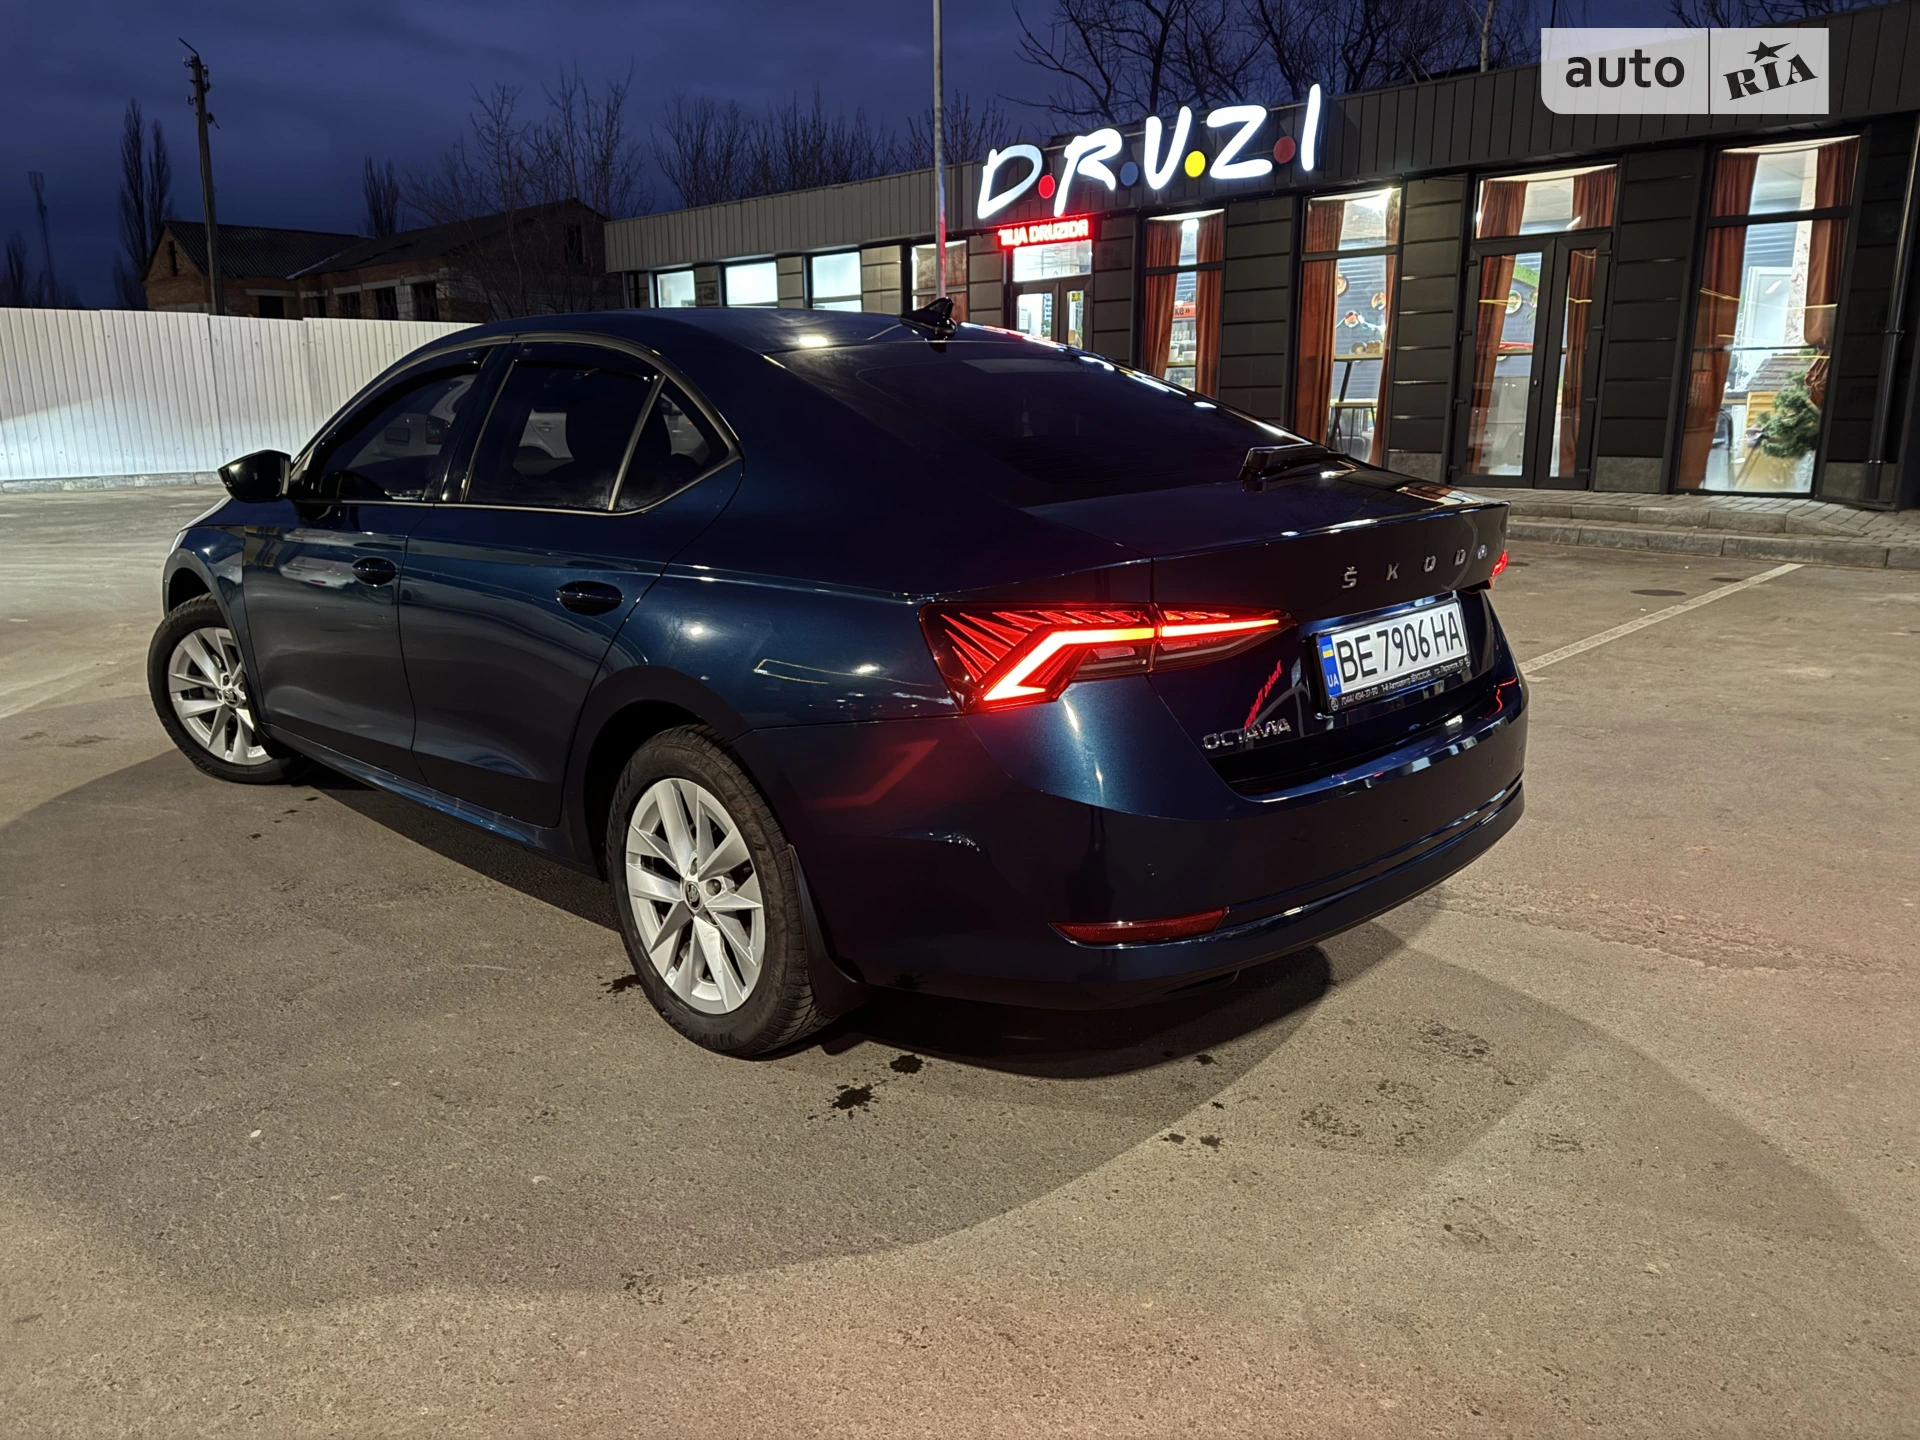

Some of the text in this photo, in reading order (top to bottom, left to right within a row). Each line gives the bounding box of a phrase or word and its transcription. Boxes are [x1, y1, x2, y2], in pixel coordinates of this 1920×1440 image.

[1341, 544, 1488, 589] ŠKODA
[1326, 673, 1340, 688] UA
[1203, 718, 1292, 750] OCTAVIA
